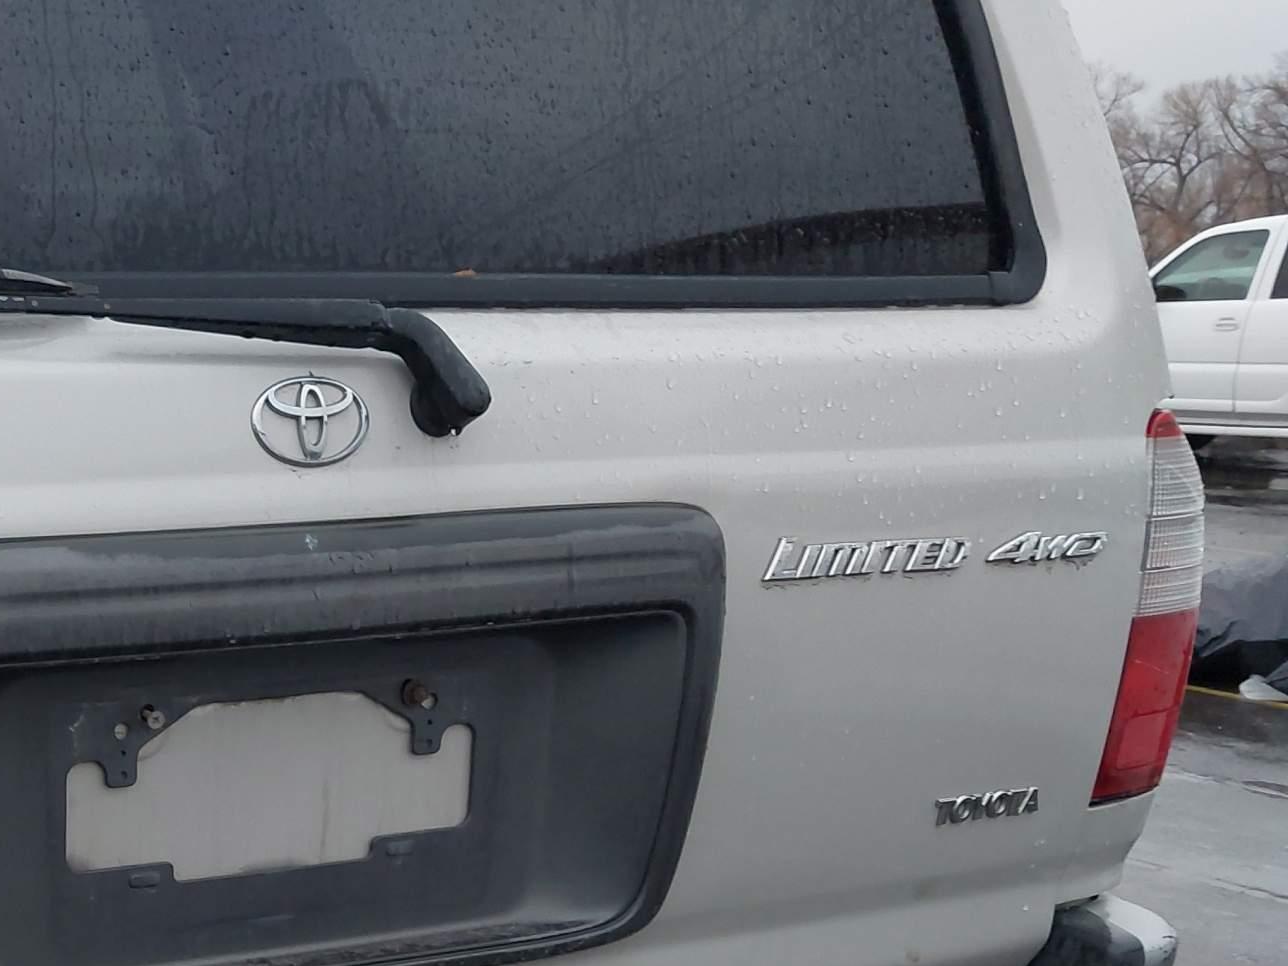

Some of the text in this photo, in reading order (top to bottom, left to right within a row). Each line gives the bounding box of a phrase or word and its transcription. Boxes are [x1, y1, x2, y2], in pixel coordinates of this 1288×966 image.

[762, 531, 1109, 581] LIMITED 4WD
[934, 786, 1039, 826] TOYOTA
